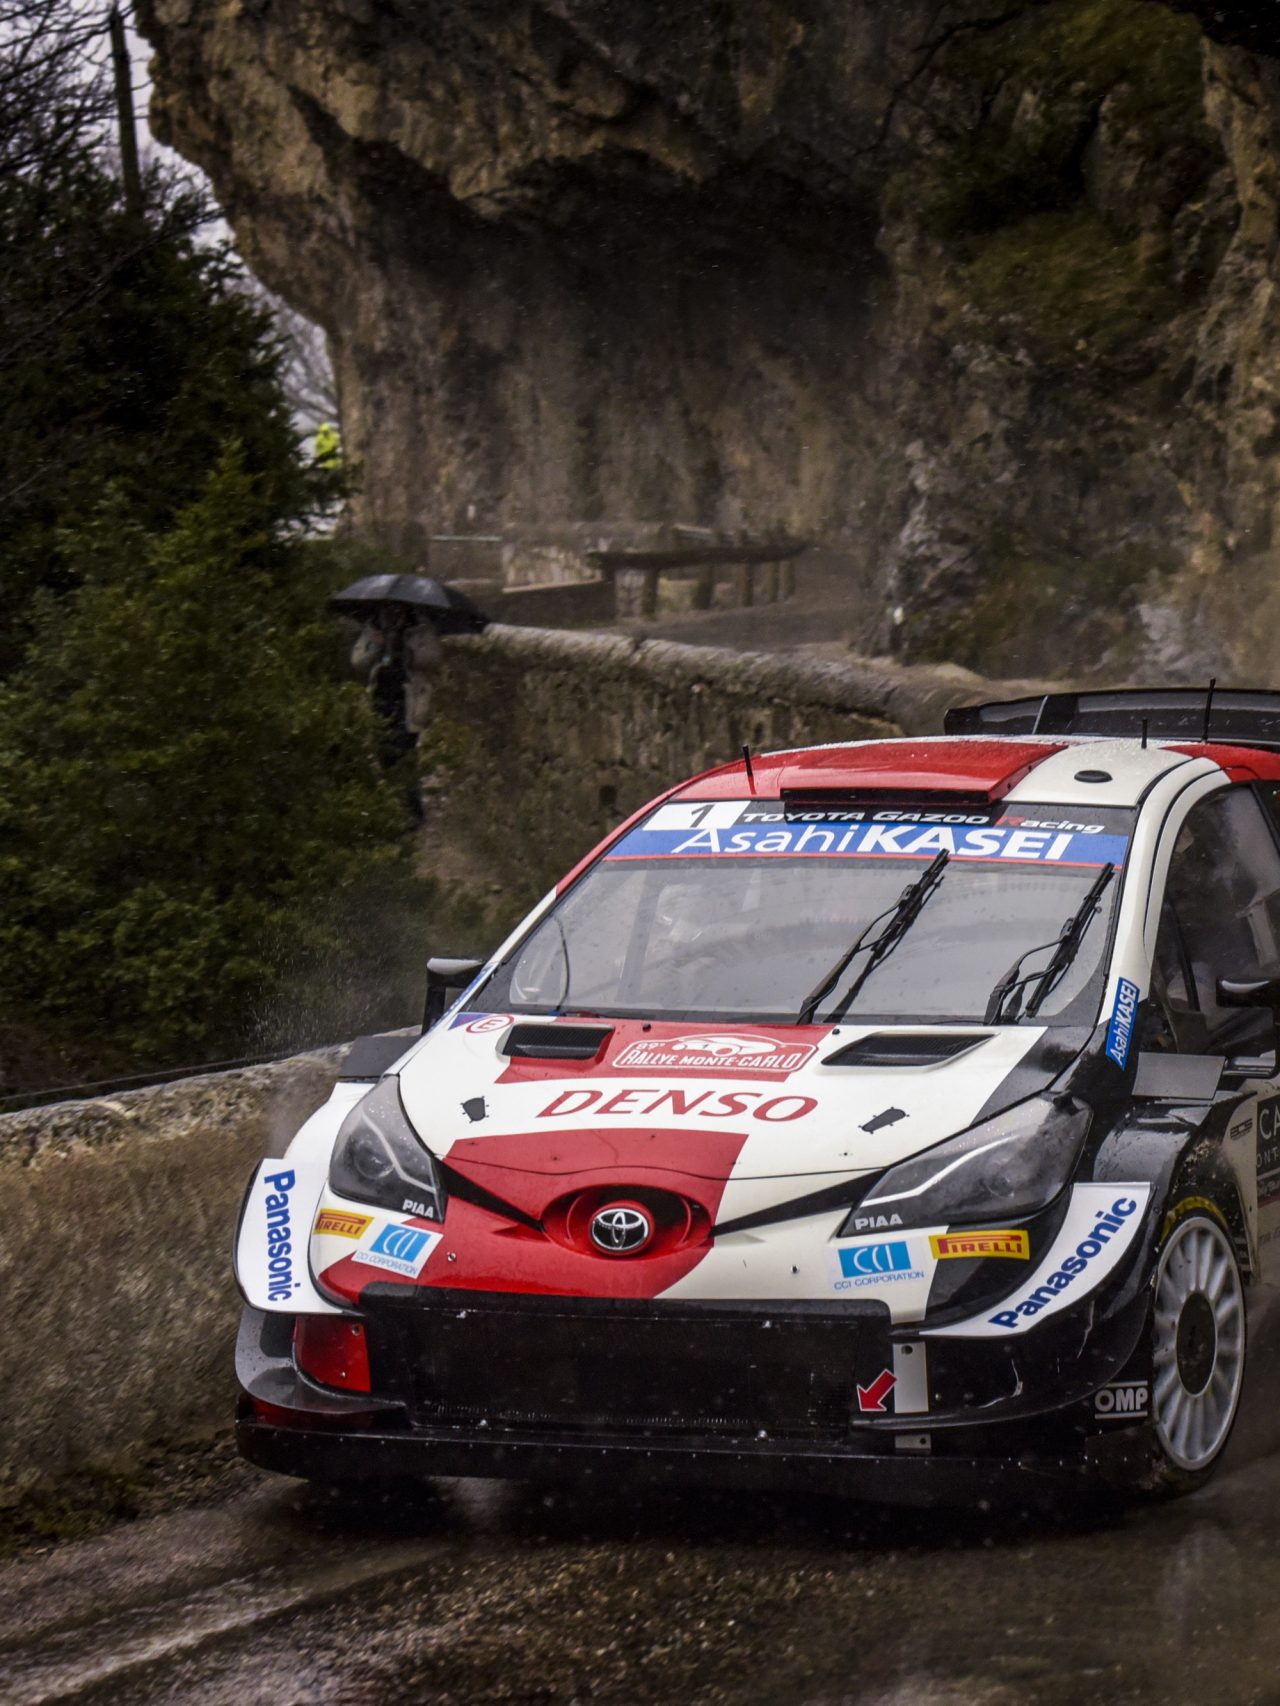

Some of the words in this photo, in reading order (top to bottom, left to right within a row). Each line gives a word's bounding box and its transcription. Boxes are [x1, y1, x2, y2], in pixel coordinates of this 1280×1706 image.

[690, 804, 717, 828] 1
[742, 811, 863, 824] TOYOTA
[872, 811, 989, 824] GAZOO
[994, 815, 1105, 834] Racing
[671, 824, 1074, 861] AsahiKASEI
[1110, 980, 1137, 1066] AsahiKASEI
[621, 1050, 679, 1065] RALLYE
[535, 1089, 819, 1122] DENSO
[402, 1199, 434, 1219] PIAA
[854, 1213, 904, 1231] PIAA
[264, 1168, 300, 1302] Panasonic
[937, 1235, 1022, 1255] PIRELLI
[368, 1255, 418, 1275] CORPORATION
[853, 1245, 894, 1273] CCI
[988, 1196, 1137, 1329] Panasonic
[834, 1281, 852, 1290] CCI
[854, 1271, 925, 1287] CORPORATION
[1095, 1387, 1148, 1412] OMP
